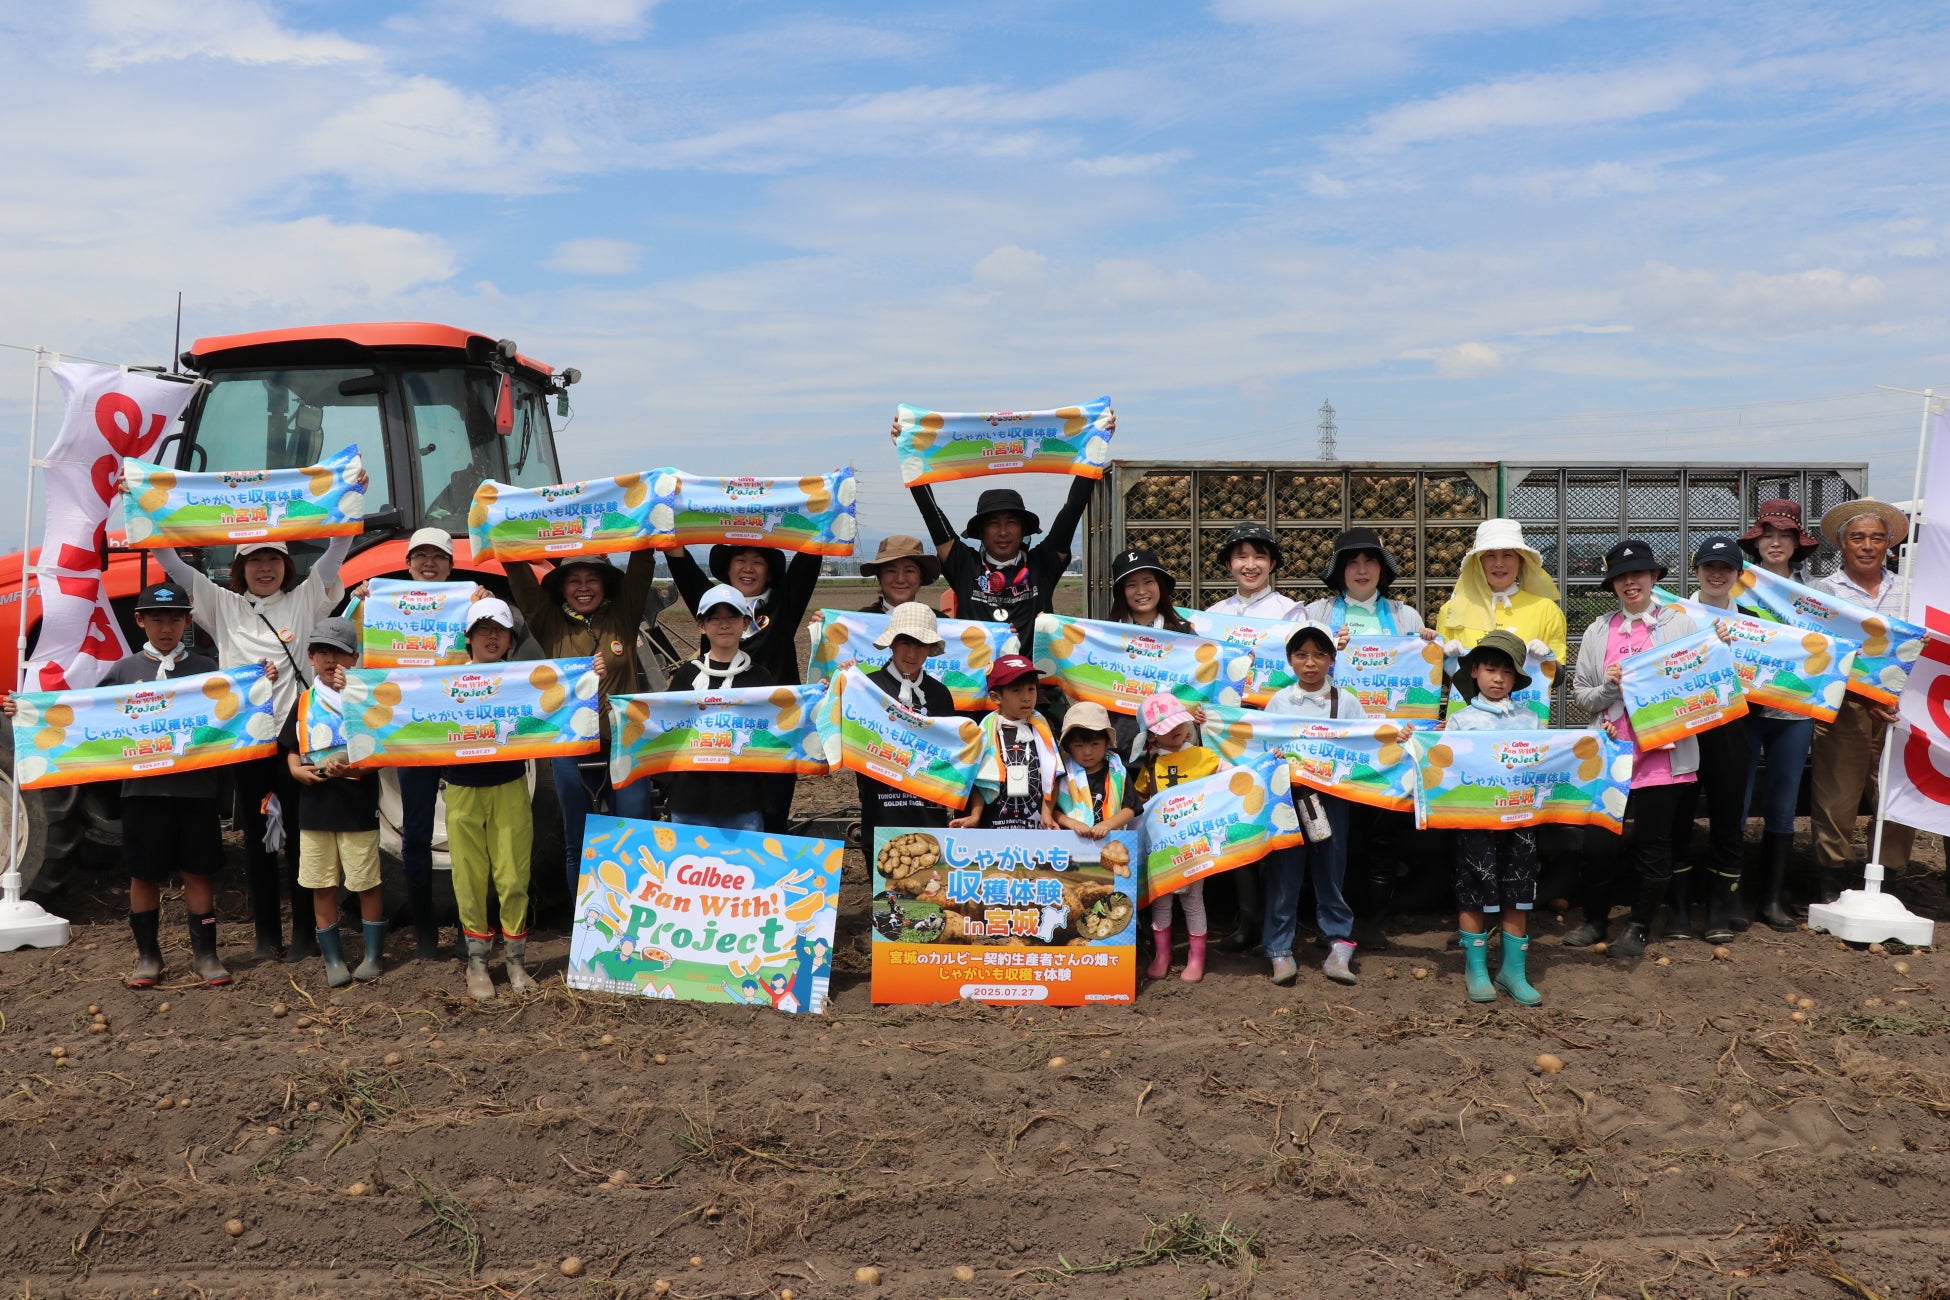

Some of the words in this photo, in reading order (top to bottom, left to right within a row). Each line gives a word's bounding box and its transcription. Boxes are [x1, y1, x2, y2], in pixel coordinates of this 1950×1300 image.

[952, 427, 1057, 442] じゃがいも収穫体験
[223, 473, 264, 483] Project
[186, 489, 304, 506] じゃがいも収穫体験
[541, 485, 581, 497] Project
[726, 485, 765, 496] Project
[504, 501, 619, 521] じゃがいも収穫体験
[398, 600, 438, 611] Project
[1792, 599, 1830, 619] Project
[1227, 635, 1258, 645] Project
[1728, 626, 1767, 642] Project
[1126, 644, 1164, 658] Project
[563, 663, 586, 671] Calbee
[1087, 651, 1190, 684] じゃがいも収穫体験
[1351, 656, 1390, 666] Project
[1664, 655, 1703, 676] Project
[450, 685, 493, 697] Project
[453, 680, 468, 688] Fan
[469, 679, 491, 688] With!
[1634, 667, 1734, 708] じゃがいも収穫体
[125, 700, 167, 714] Project
[411, 704, 534, 722] じゃがいも収穫体験
[84, 714, 209, 741] じゃがいも収穫体験
[661, 713, 770, 732] じゃがいも収穫体験
[845, 704, 952, 762] じゃがいも収穫体験
[1500, 752, 1540, 764] Project
[1461, 771, 1571, 787] じゃがいも収穫体験
[1162, 803, 1200, 824] Project
[944, 836, 1069, 871] じゃがいも
[676, 864, 745, 891] Calbee
[946, 870, 1063, 905] 収穫体験
[637, 881, 691, 912] Fan
[699, 893, 779, 919] With!
[624, 904, 784, 954] Project
[889, 950, 1119, 967] 宮城のカルビー契約生産者さんの畑で
[939, 967, 1072, 982] じゃがいも収穫を体験
[973, 988, 1034, 997] 2025.07.27
